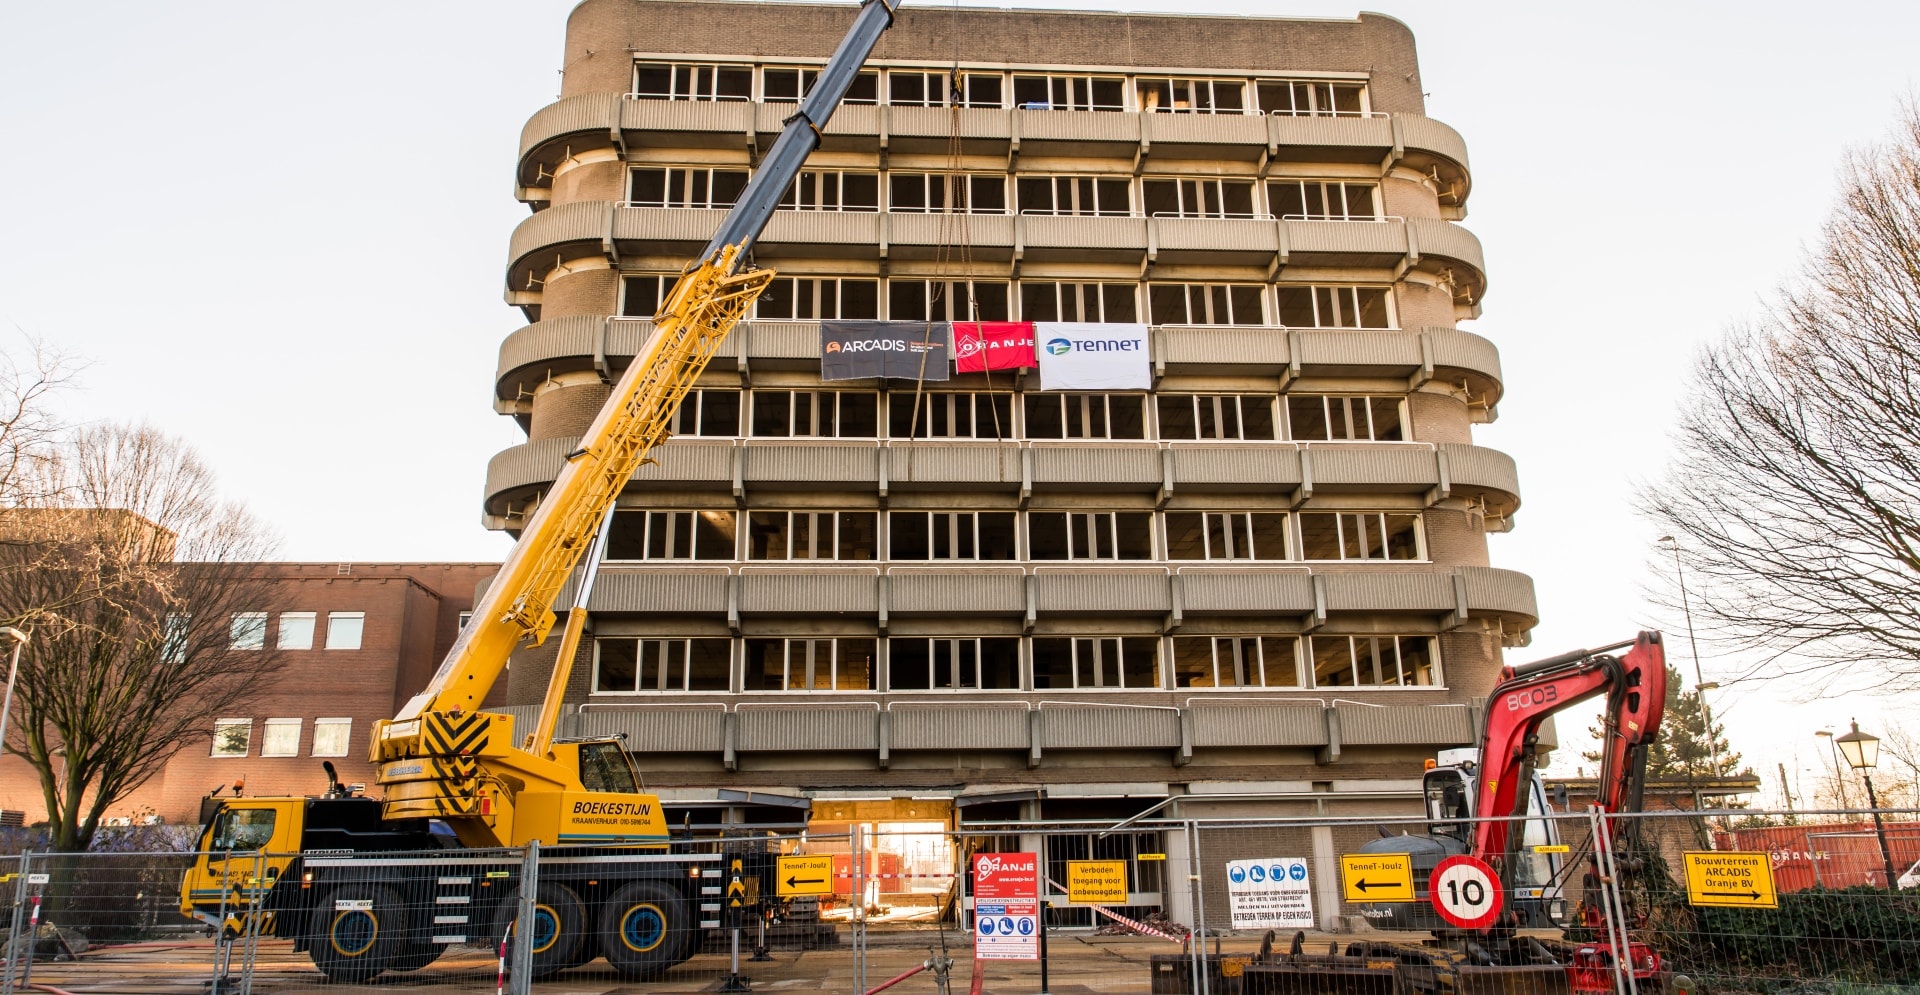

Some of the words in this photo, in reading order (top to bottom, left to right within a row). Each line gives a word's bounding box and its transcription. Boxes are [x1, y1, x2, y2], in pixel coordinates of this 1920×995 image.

[842, 339, 906, 353] ARCADIS
[963, 339, 1034, 351] ORANJE
[1517, 684, 1558, 712] 8003
[573, 802, 651, 815] BOEKESTIJN
[1694, 856, 1759, 866] Bouwterrein
[981, 862, 1035, 872] ORANJE
[1080, 866, 1114, 874] Verboden
[1705, 867, 1752, 877] ARCADIS
[1073, 878, 1103, 886] toegang
[1705, 878, 1738, 889] Oranje
[1741, 879, 1754, 888] BV
[1073, 888, 1122, 897] onbevoegden
[1447, 879, 1485, 906] 10
[1233, 912, 1257, 921] BETREDEN
[1257, 912, 1275, 920] TERREIN
[1276, 911, 1282, 920] OP
[1283, 911, 1296, 920] EIGEN
[1296, 910, 1312, 920] RISICO
